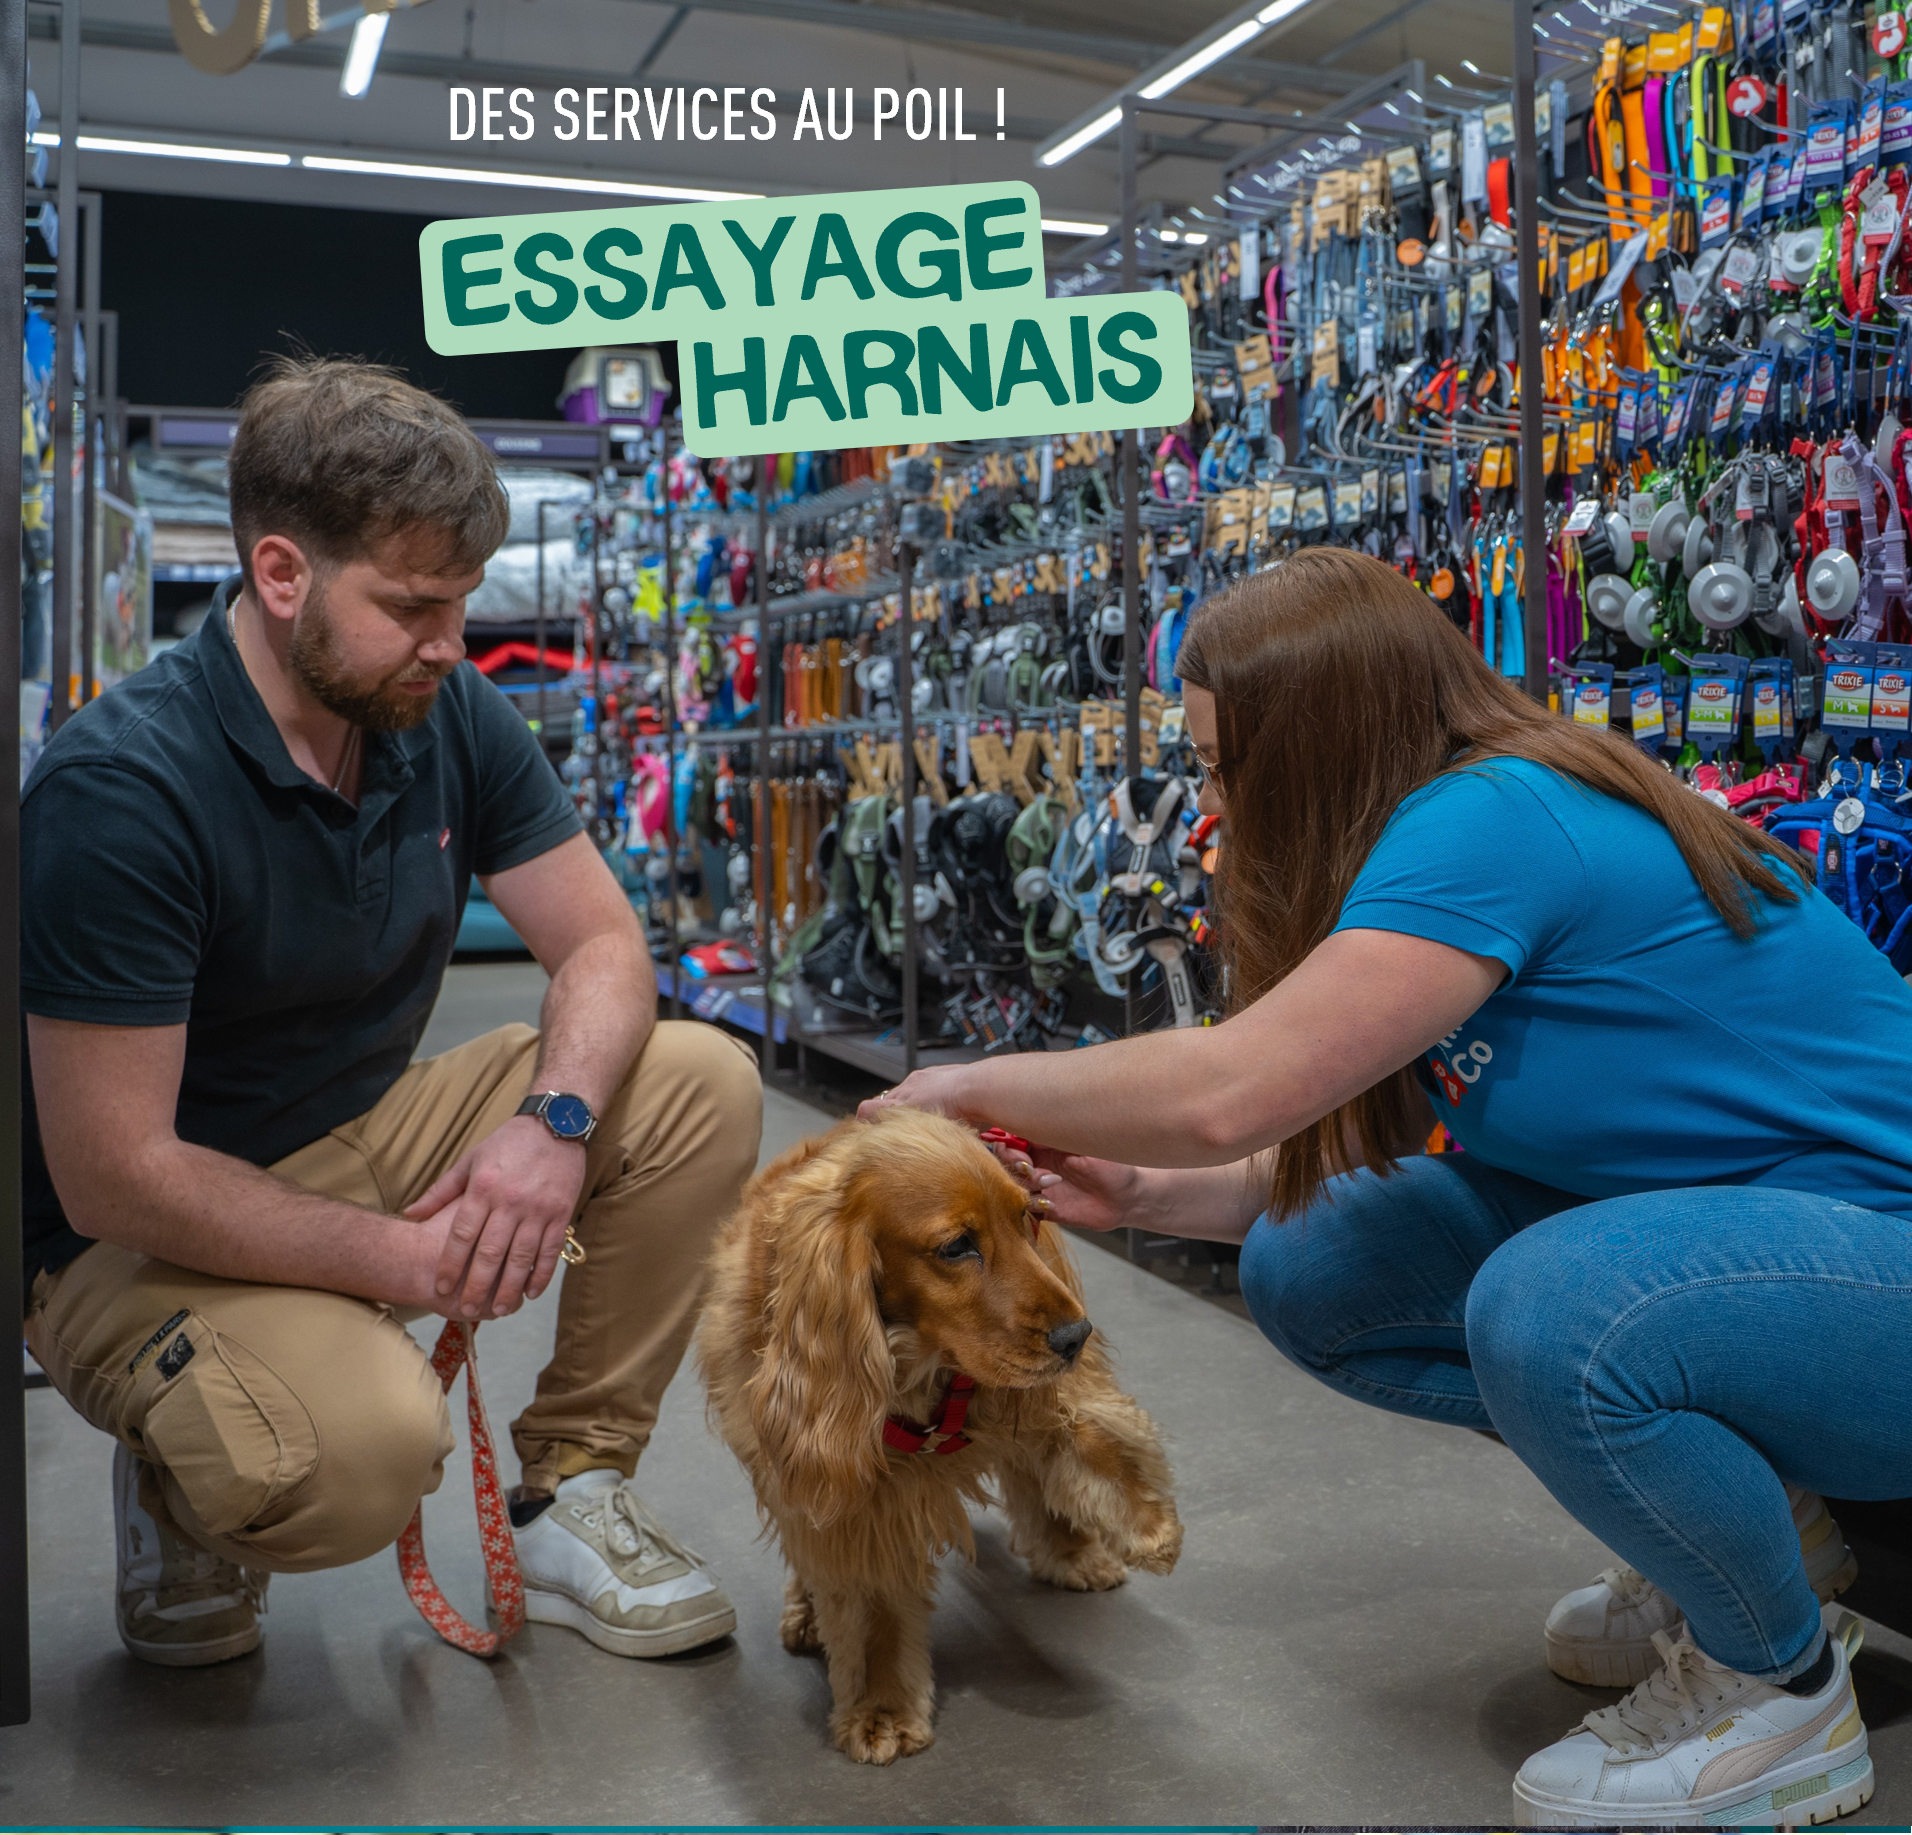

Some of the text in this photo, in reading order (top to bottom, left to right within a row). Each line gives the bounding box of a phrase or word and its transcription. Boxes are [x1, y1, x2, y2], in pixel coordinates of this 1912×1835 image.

[1832, 674, 1864, 688] TRIXIE
[1878, 677, 1905, 690] TRIXIE
[1697, 686, 1727, 698] TRIXIE
[1832, 699, 1844, 712] M
[1879, 702, 1887, 714] S
[1694, 708, 1713, 719] S-M
[1705, 1717, 1736, 1743] PUMA
[1782, 1778, 1820, 1803] PUMA
